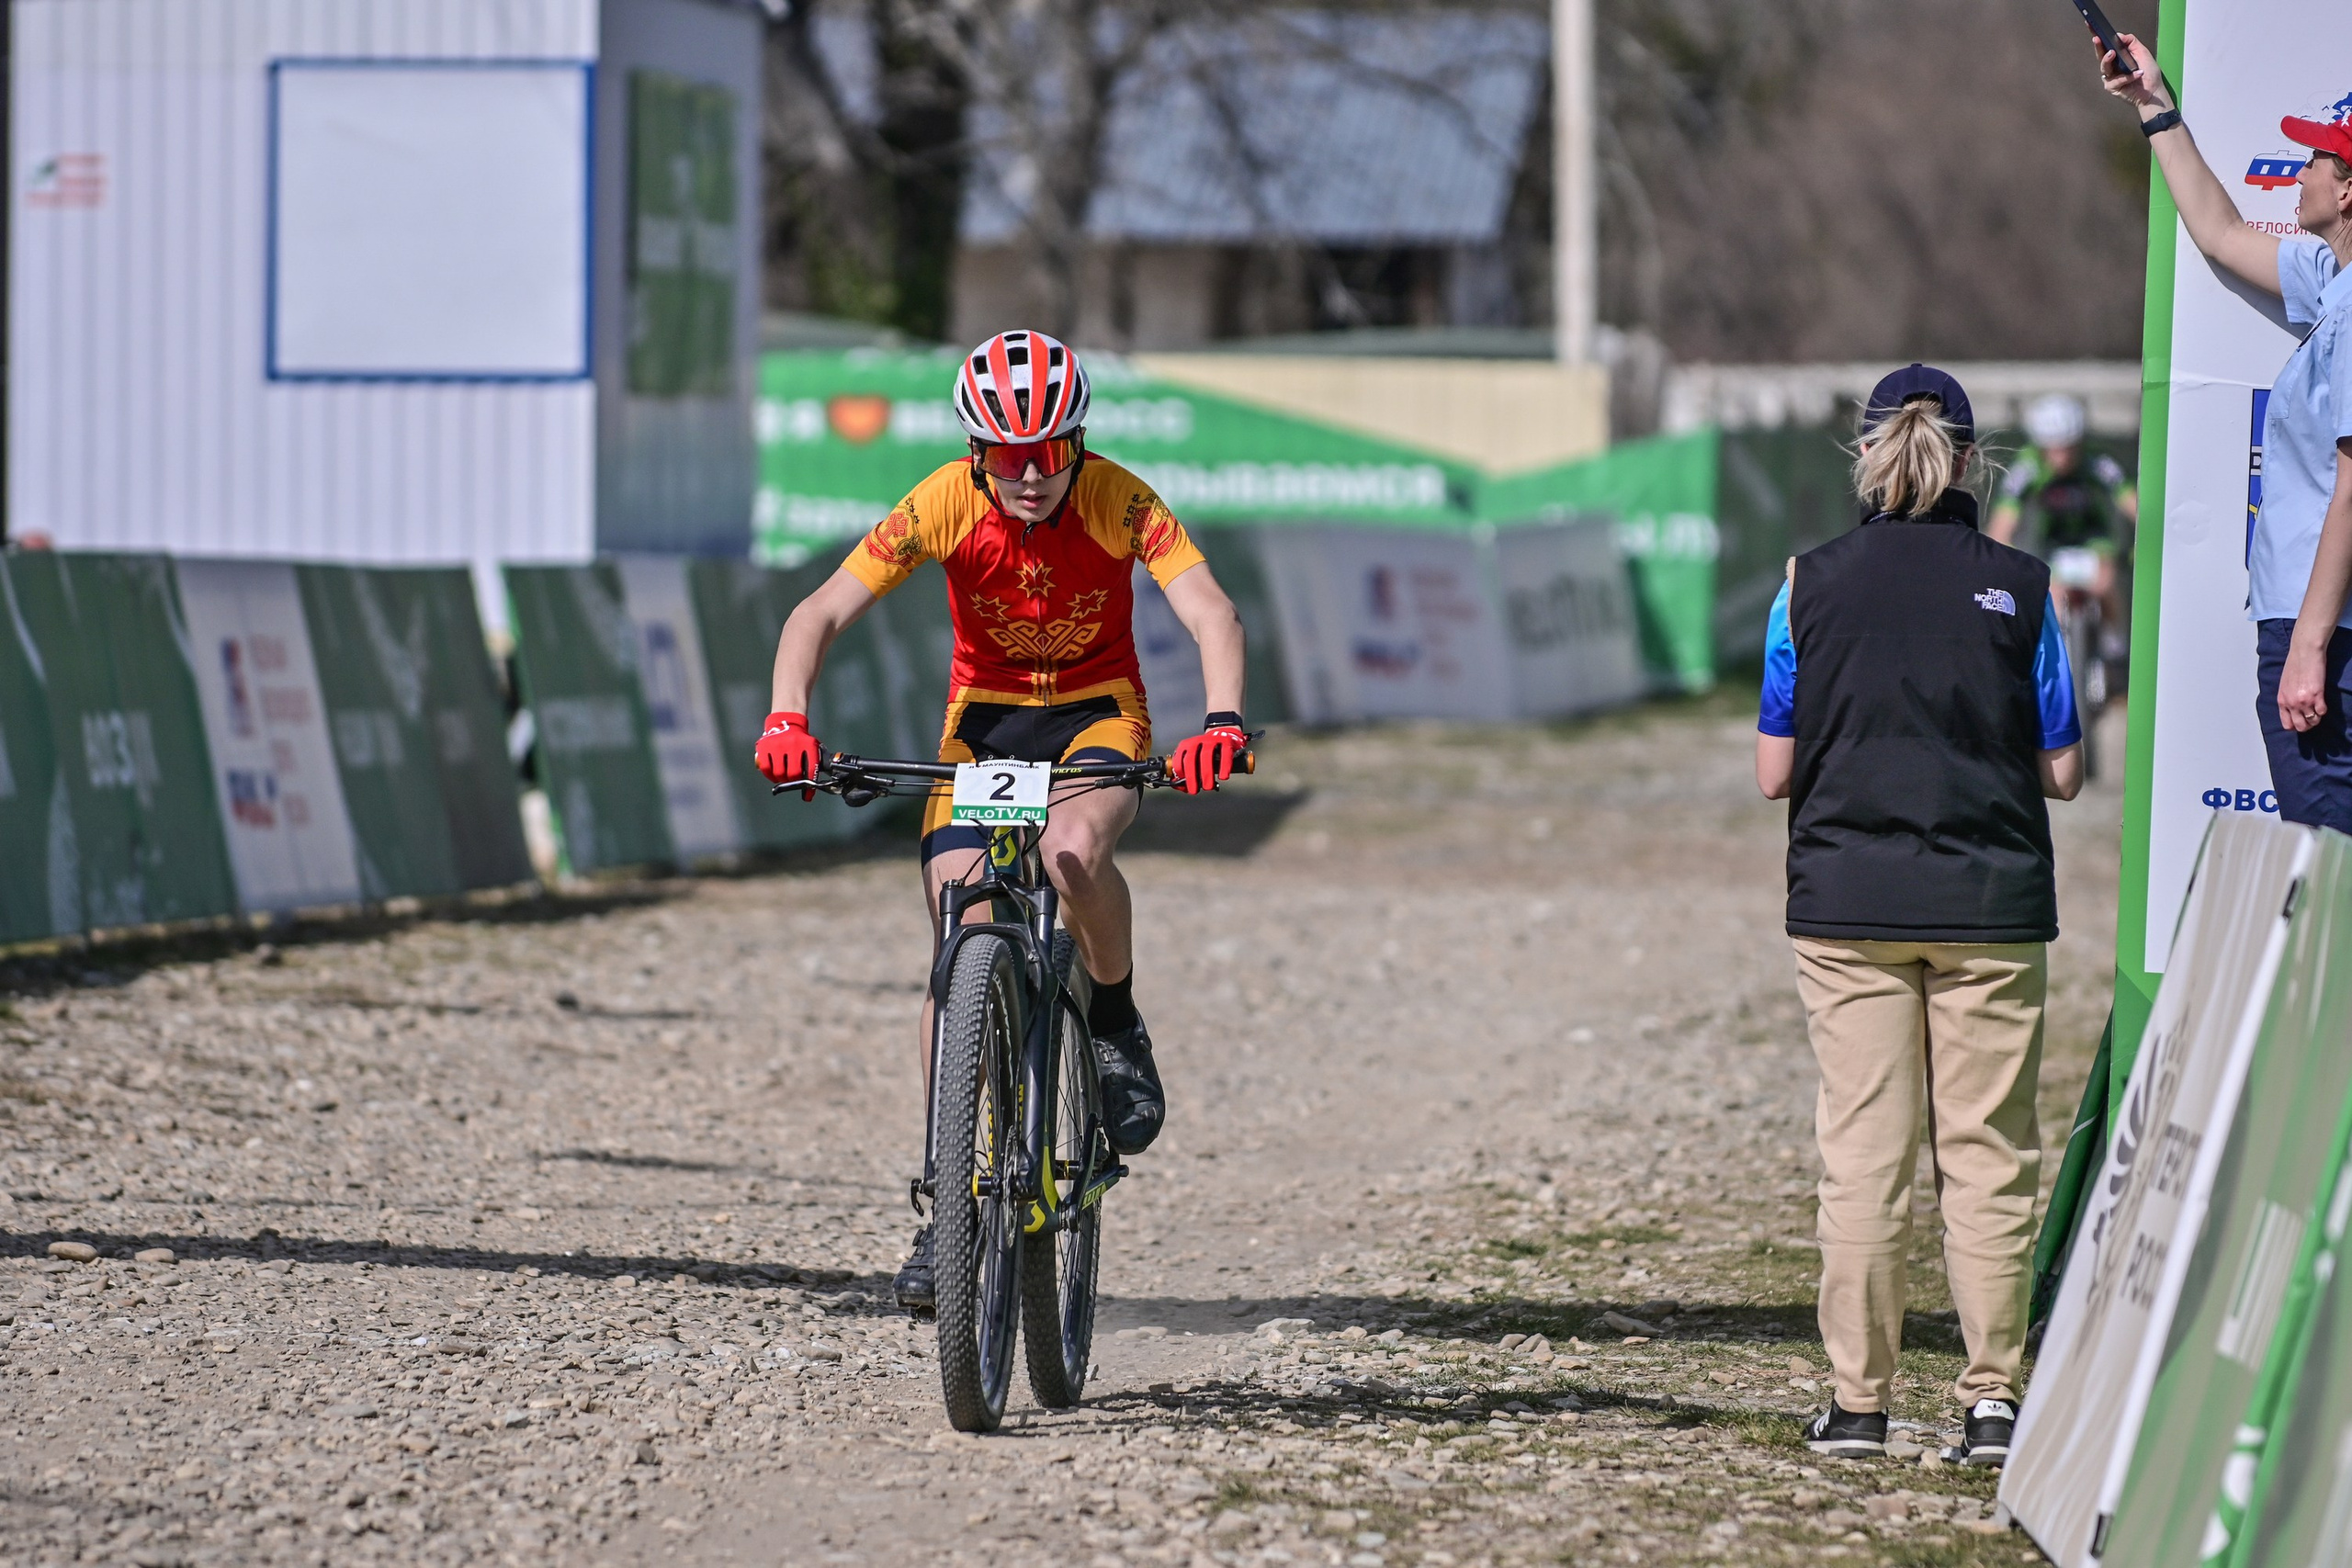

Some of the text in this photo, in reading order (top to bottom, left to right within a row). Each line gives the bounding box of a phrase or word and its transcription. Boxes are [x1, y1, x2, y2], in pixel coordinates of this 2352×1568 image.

[2246, 221, 2313, 235] ЕЛОСИ
[1974, 593, 2004, 604] NORTH
[1986, 588, 2004, 597] THE
[1982, 602, 2004, 612] FACE
[989, 773, 1016, 801] 2
[2201, 787, 2279, 813] ФВС
